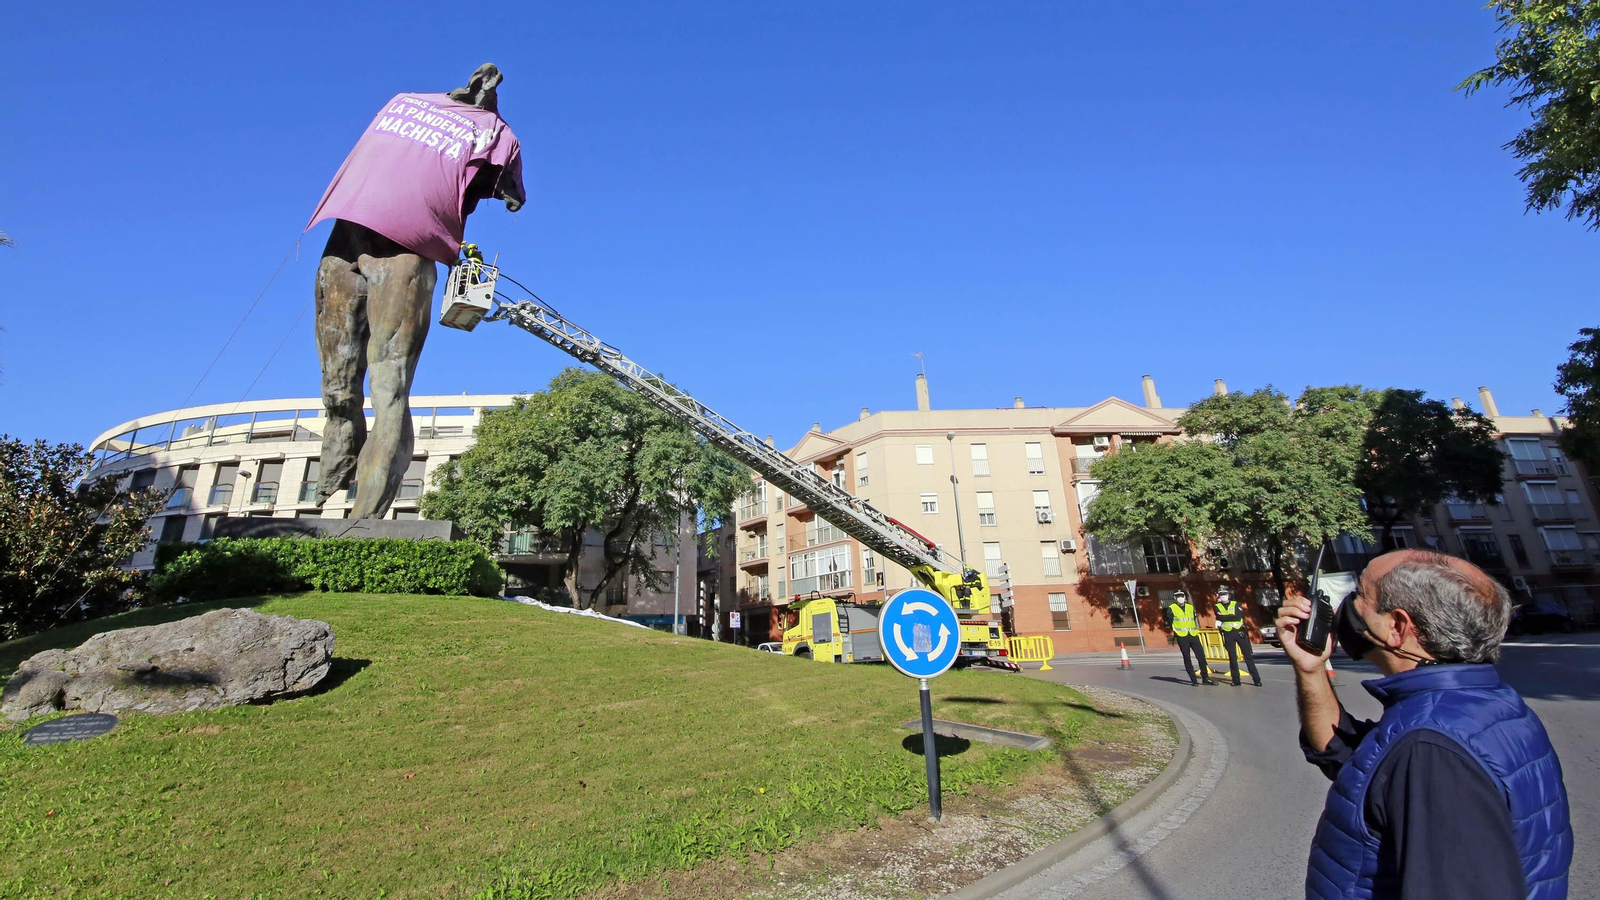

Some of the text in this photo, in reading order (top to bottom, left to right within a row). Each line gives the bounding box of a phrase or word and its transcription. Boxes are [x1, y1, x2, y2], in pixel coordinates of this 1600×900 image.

[375, 116, 463, 159] MACHISTA
[388, 103, 476, 144] LA PANDEMIA
